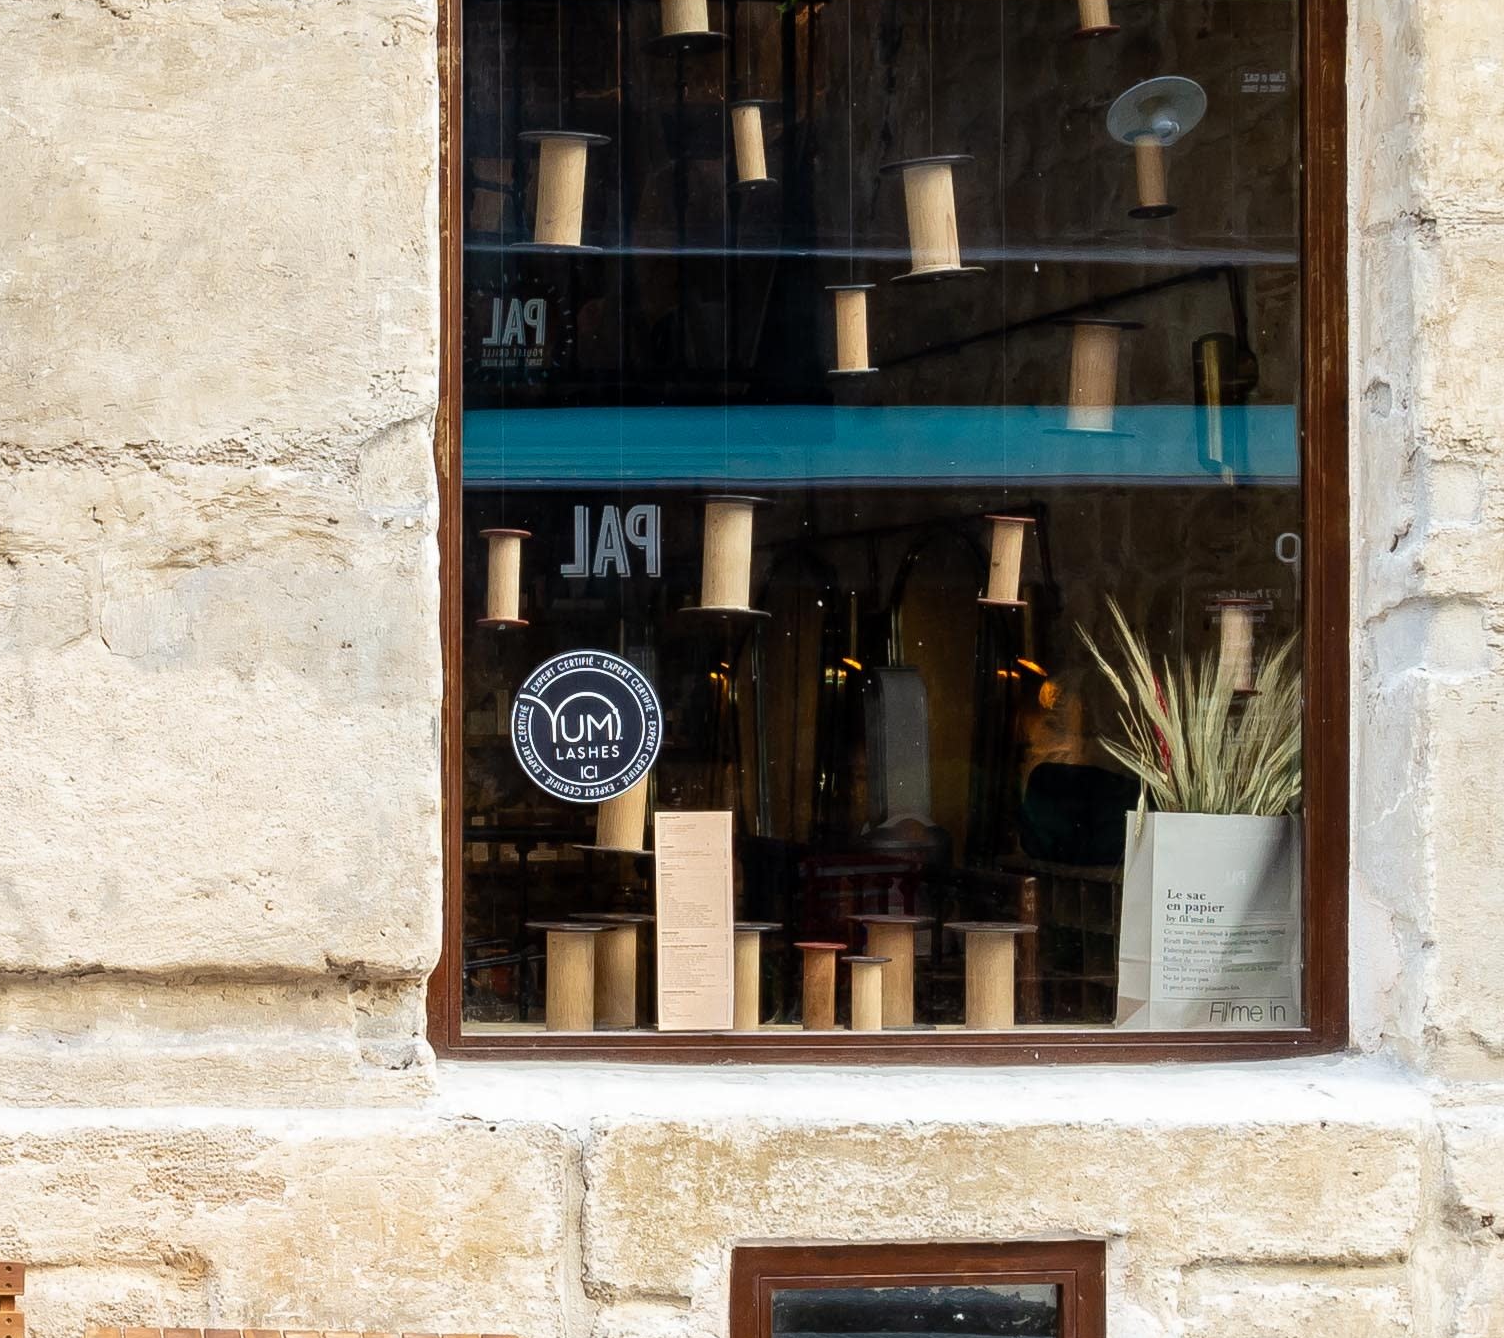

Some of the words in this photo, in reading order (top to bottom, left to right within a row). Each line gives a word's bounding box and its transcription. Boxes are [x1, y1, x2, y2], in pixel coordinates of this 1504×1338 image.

[530, 667, 556, 693] EXPERT
[557, 656, 594, 672] CERTIFIÉ
[602, 659, 632, 679] EXPERT
[630, 677, 656, 713] CERTIFIÉ
[517, 704, 530, 743] CERTIFIÉ
[646, 720, 657, 753] EXPERT
[521, 745, 543, 774] EXPERT
[556, 745, 620, 760] LASHES
[580, 765, 598, 779] ICI
[620, 753, 649, 786] CERTIFIÉ
[544, 776, 582, 797] CERTIFIÉ
[584, 782, 616, 797] EXPERT
[1167, 889, 1182, 900] Le
[1186, 891, 1206, 900] sac
[1166, 903, 1181, 911] en
[1185, 902, 1224, 915] papier
[1166, 914, 1177, 924] by
[1206, 915, 1215, 924] in
[1209, 1001, 1263, 1022] Fil'me
[1270, 1001, 1286, 1022] in
